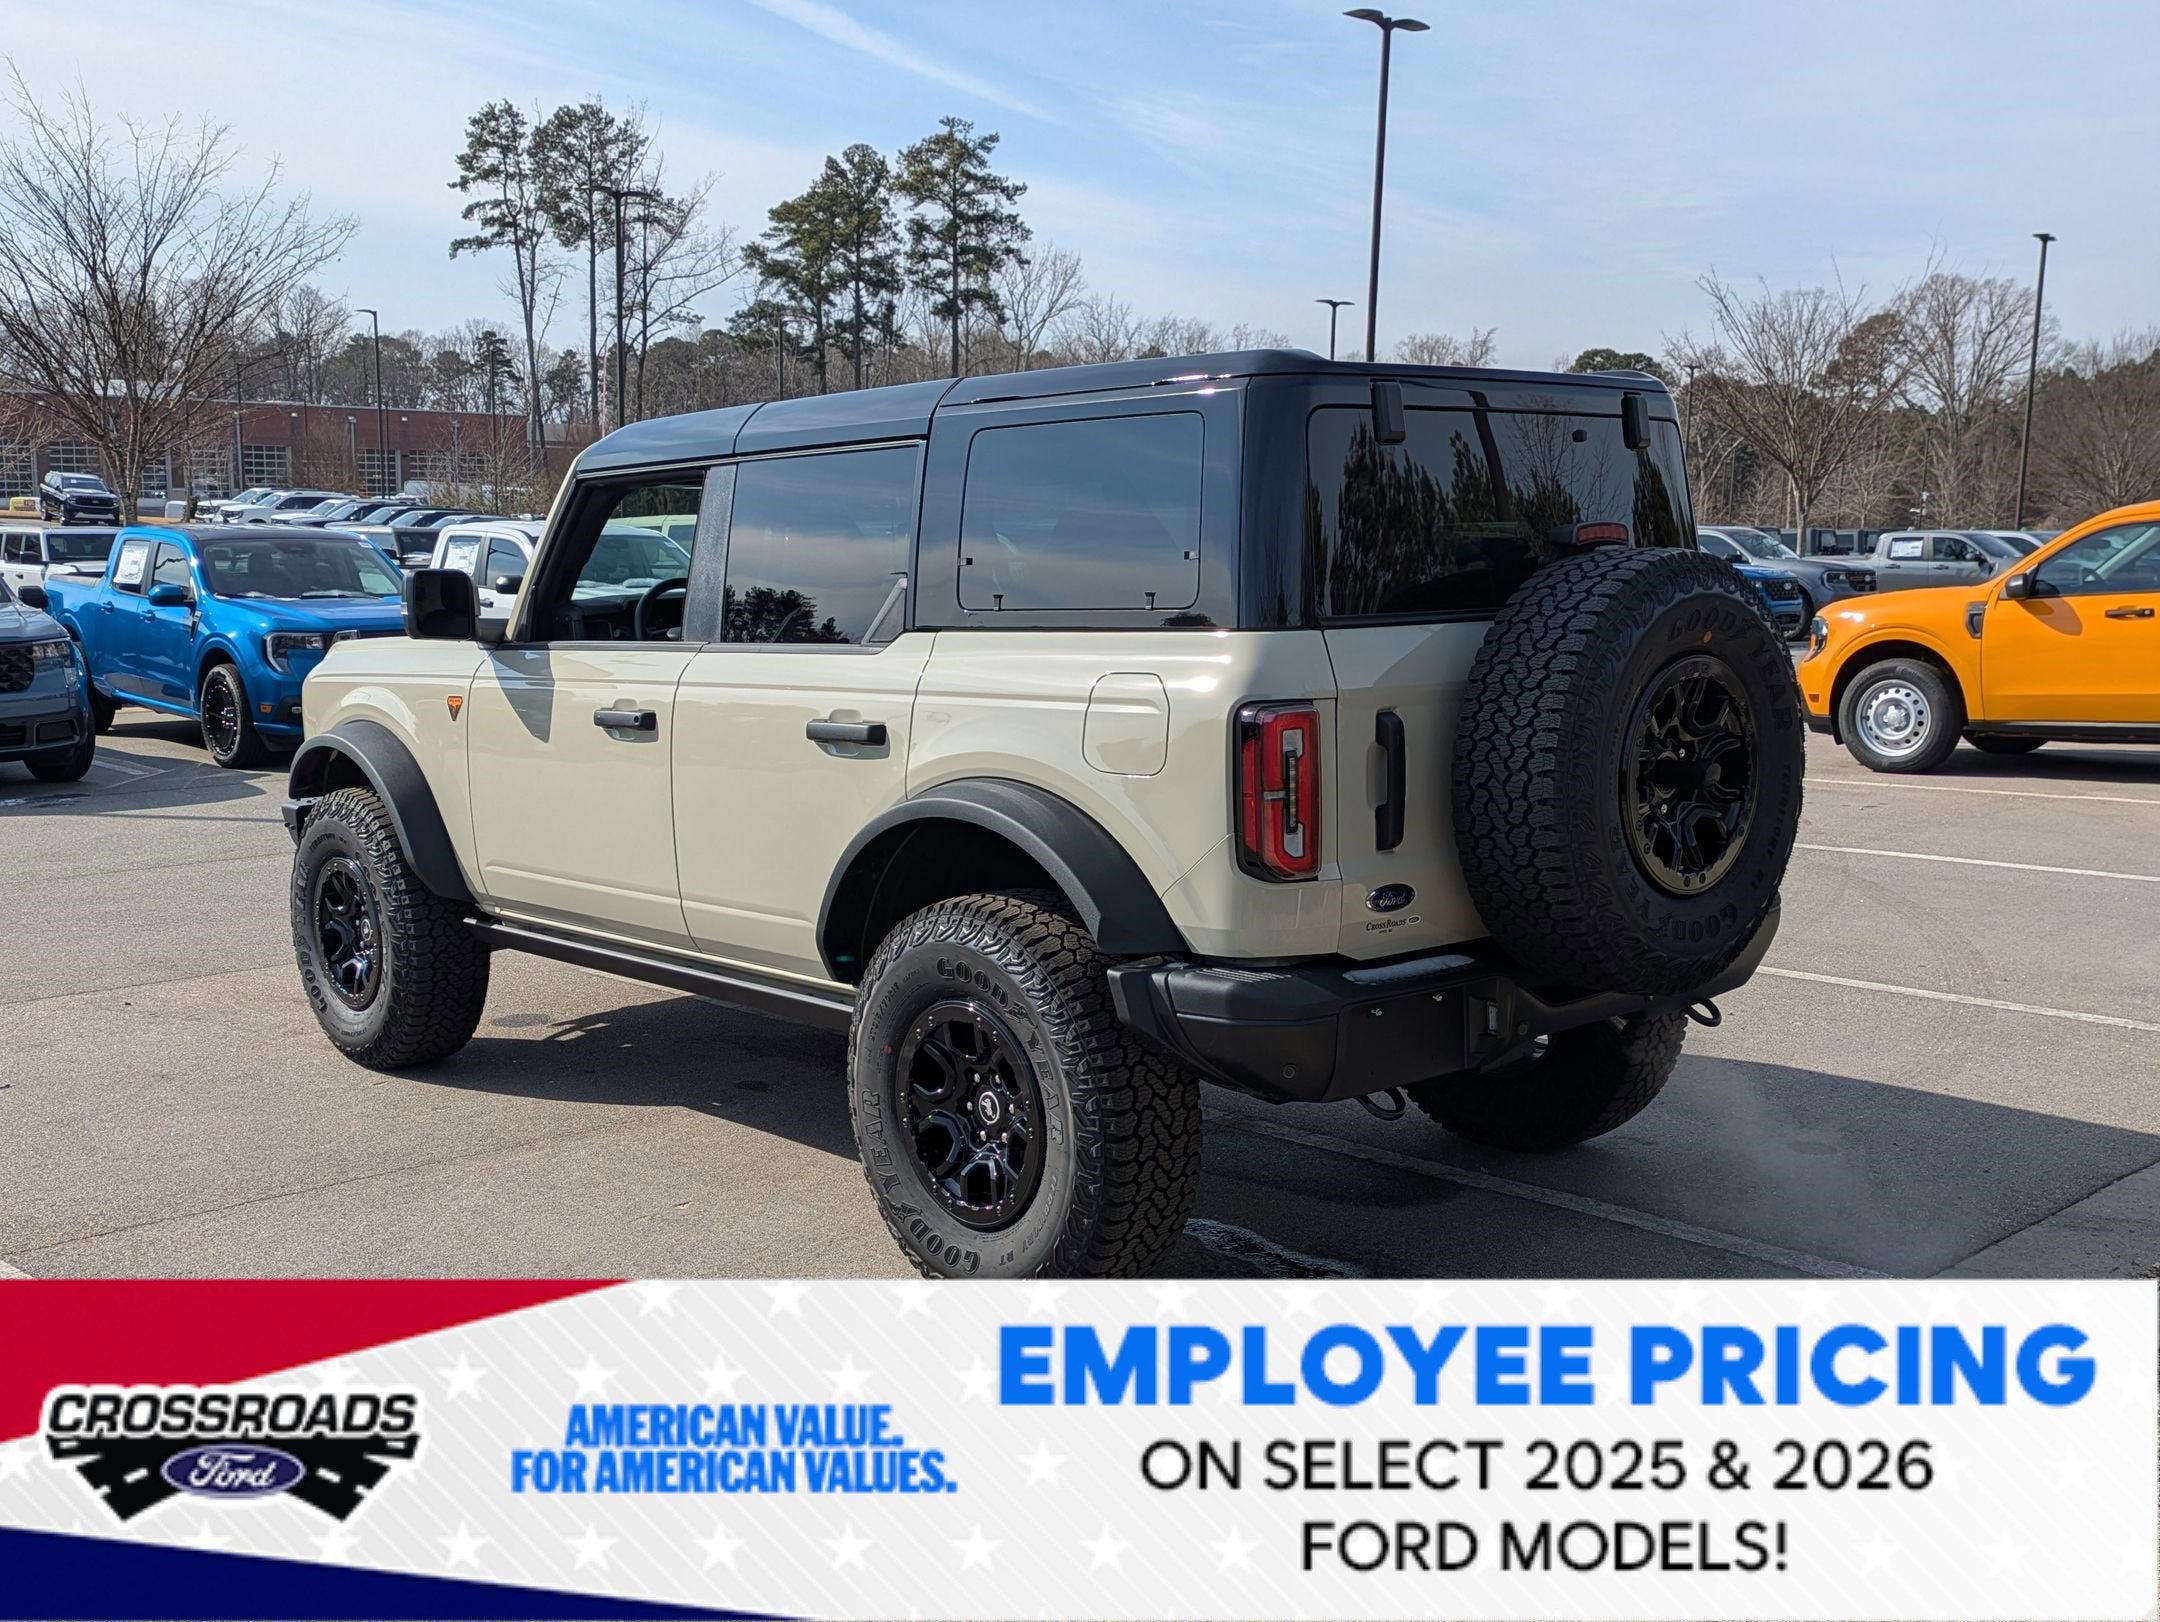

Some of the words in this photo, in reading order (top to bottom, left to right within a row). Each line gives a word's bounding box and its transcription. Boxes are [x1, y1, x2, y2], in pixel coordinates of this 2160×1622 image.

[1667, 605, 1794, 730] GOODYEAR
[936, 957, 1065, 1146] GOODYEAR
[863, 1088, 981, 1276] GOODYEAR
